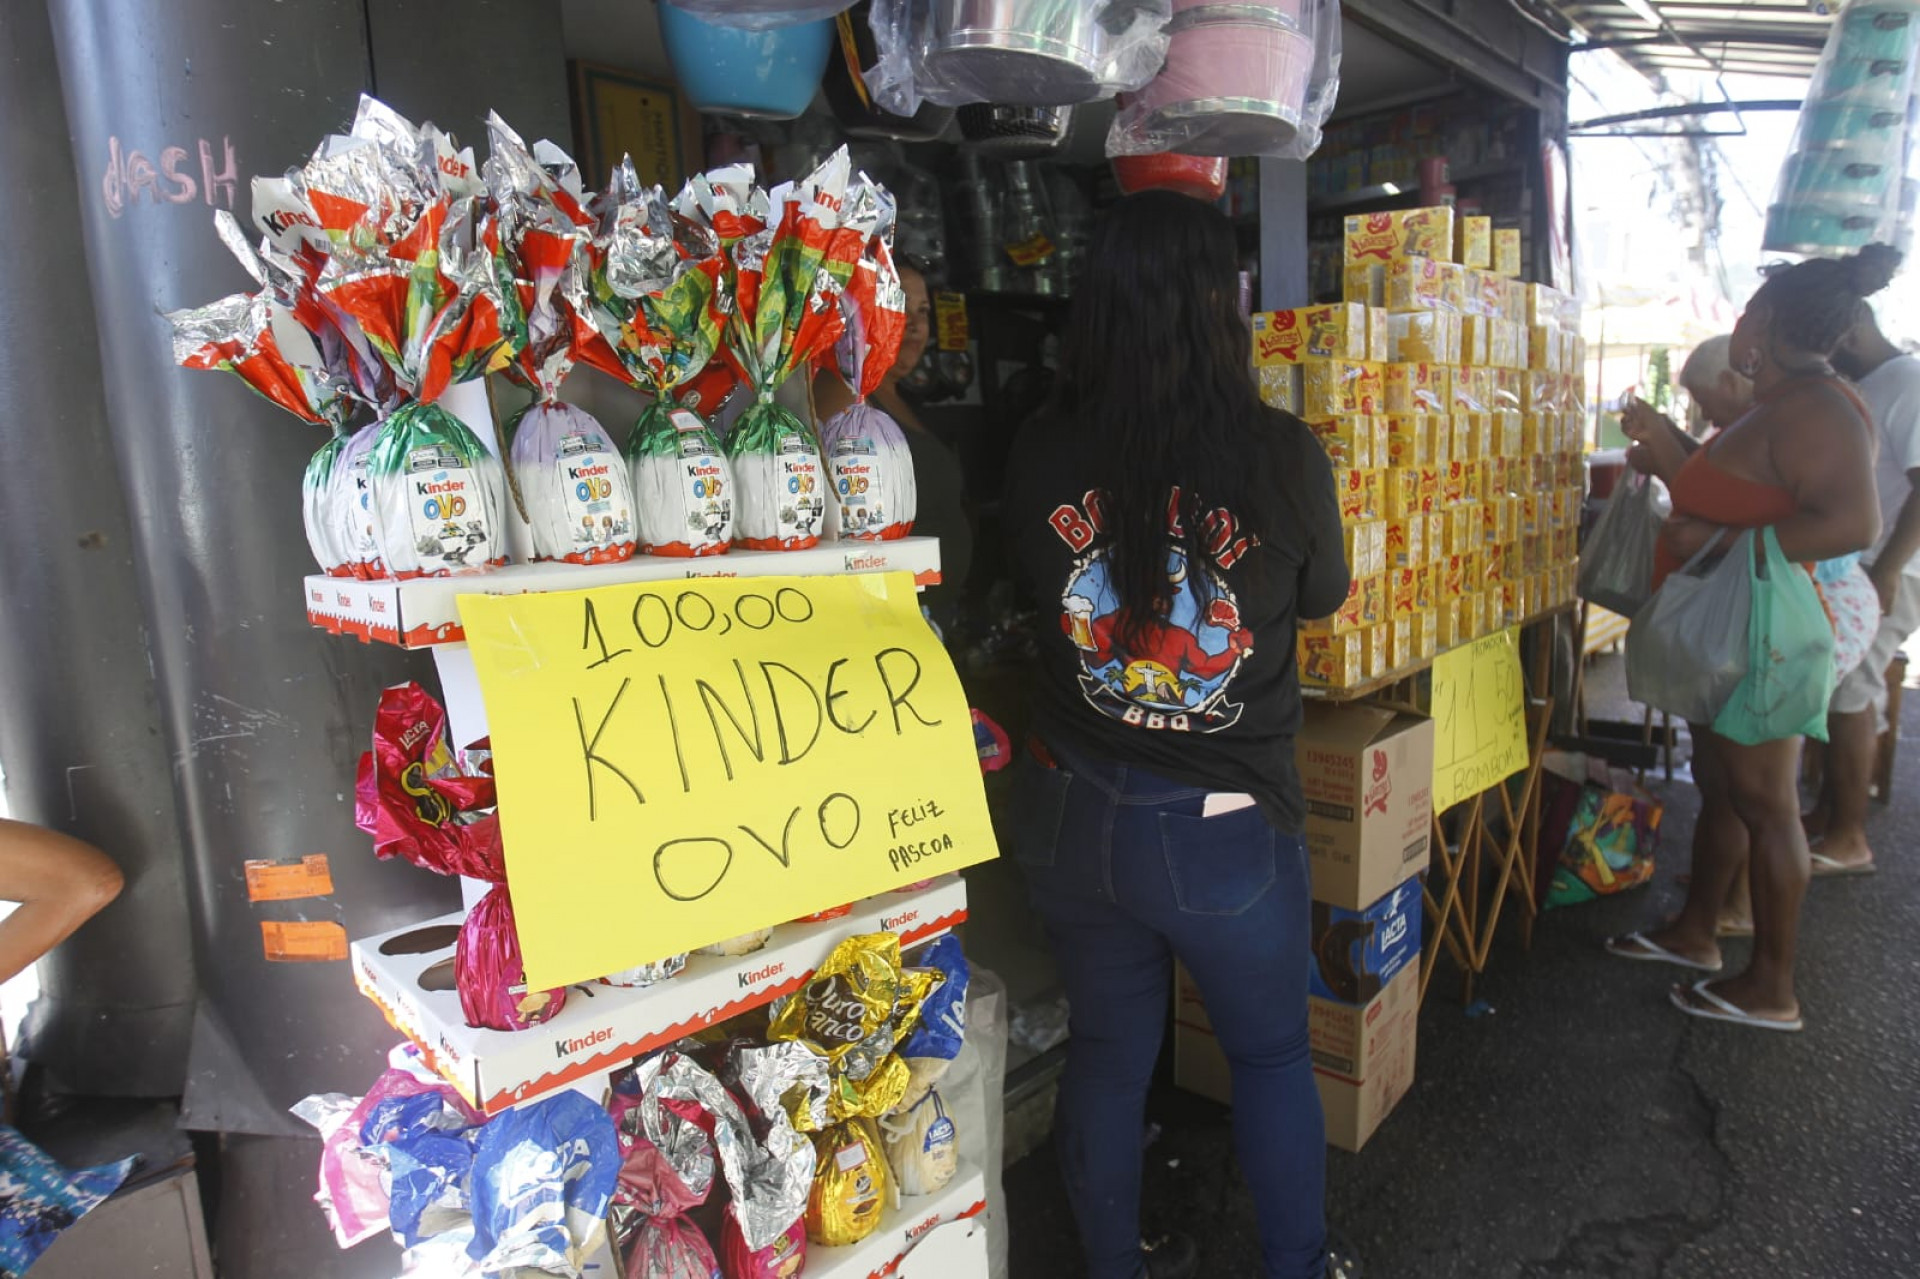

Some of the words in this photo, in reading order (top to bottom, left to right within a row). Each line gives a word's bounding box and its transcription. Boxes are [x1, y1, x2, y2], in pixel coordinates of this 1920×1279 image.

[582, 587, 813, 669] 100,00
[571, 646, 943, 822] KINDER
[1122, 706, 1190, 733] BBQ
[887, 798, 945, 839] FELIZ
[652, 792, 861, 902] OVO
[888, 833, 953, 872] PASCOA
[881, 910, 919, 932] Kinder
[1381, 912, 1408, 953] LACTA
[738, 962, 784, 988] Kinder
[556, 1023, 614, 1058] Kinder
[905, 1213, 939, 1242] Kinder
